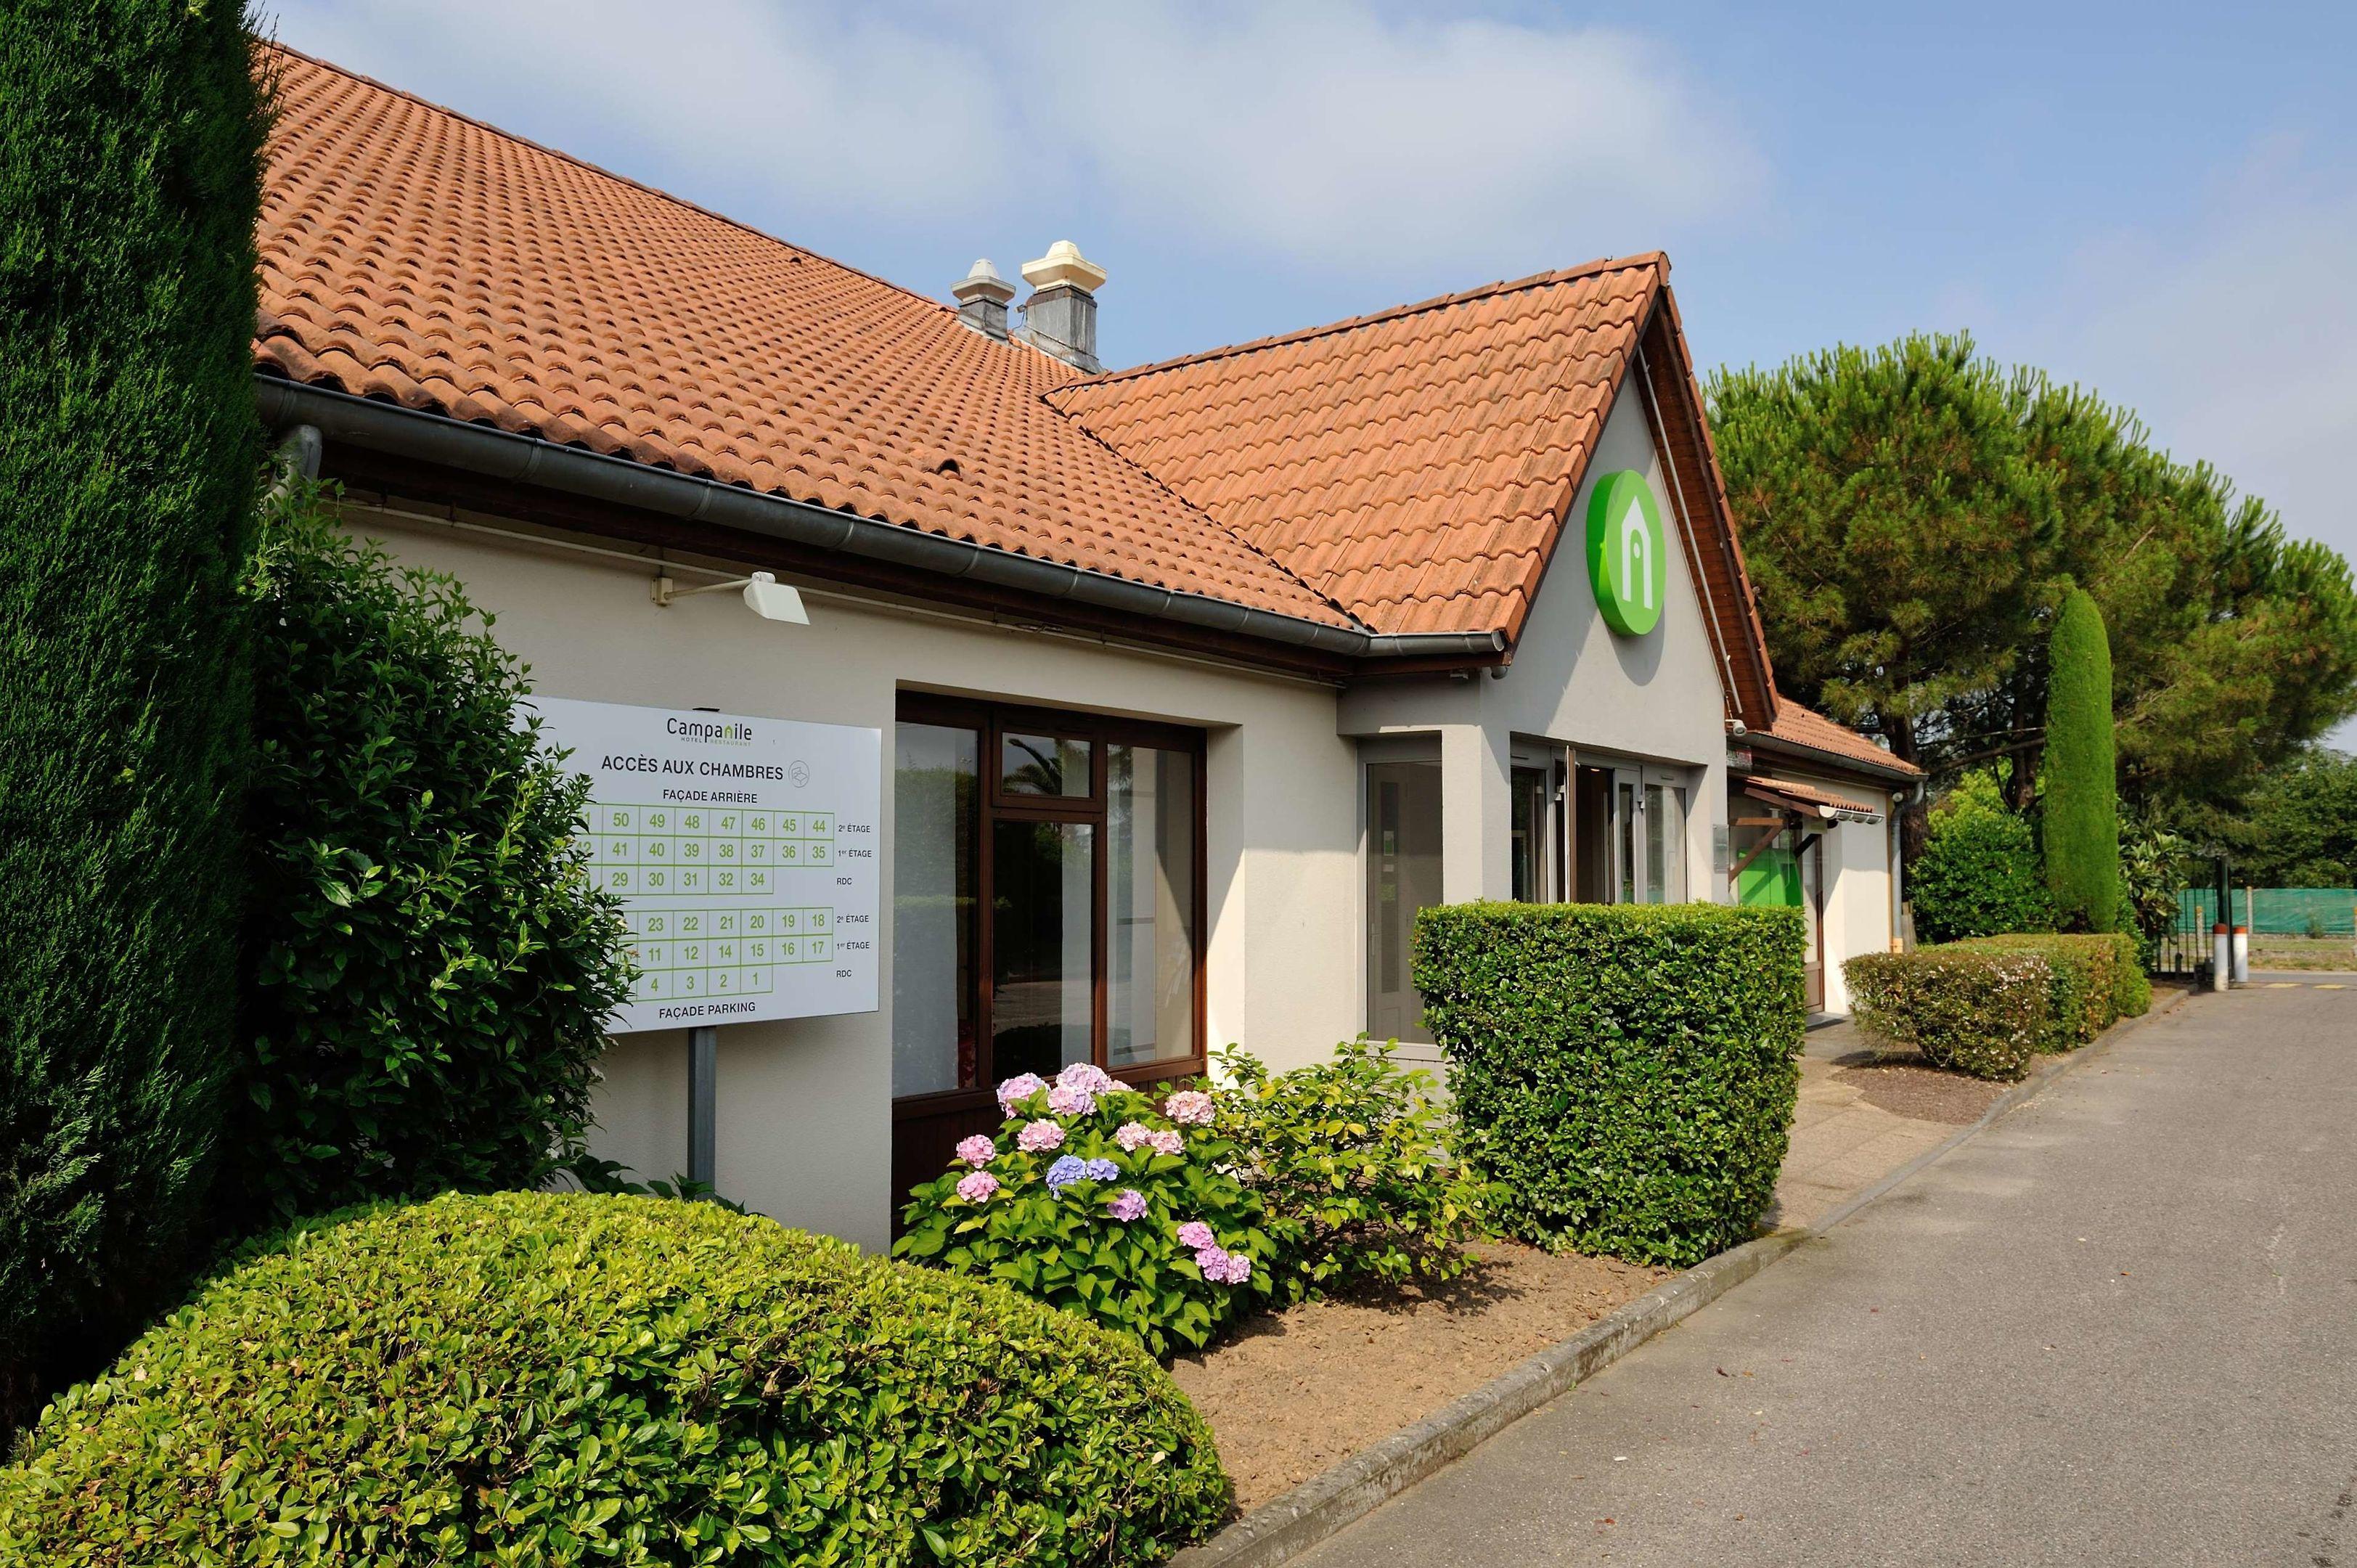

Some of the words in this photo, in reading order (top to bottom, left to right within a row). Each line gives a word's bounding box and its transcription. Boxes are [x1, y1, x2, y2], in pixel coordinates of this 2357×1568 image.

[667, 718, 752, 743] Campanile
[602, 754, 658, 772] ACCÈS
[662, 760, 694, 775] AUX
[700, 762, 783, 780] CHAMBRES
[663, 789, 708, 802] FAÇADE
[711, 791, 757, 803] ARRIÈRE
[613, 813, 629, 827] 50
[649, 814, 665, 828] 49
[685, 815, 700, 829] 48
[722, 817, 735, 830] 47
[751, 818, 765, 831] 46
[783, 820, 796, 832] 45
[812, 820, 826, 832] 44
[847, 822, 870, 833] ÉTAGE
[613, 842, 627, 856] 41
[649, 843, 664, 857] 40
[685, 844, 698, 857] 39
[719, 844, 733, 857] 38
[751, 845, 765, 857] 37
[783, 846, 796, 858] 36
[812, 846, 825, 858] 35
[849, 848, 872, 857] ÉTAGE
[612, 872, 628, 886] 29
[648, 873, 664, 886] 30
[684, 873, 698, 886] 31
[719, 873, 733, 886] 32
[751, 873, 765, 886] 34
[648, 918, 663, 931] 23
[683, 917, 698, 931] 22
[720, 915, 733, 929] 21
[750, 915, 764, 928] 20
[782, 915, 795, 928] 19
[812, 914, 825, 927] 18
[846, 914, 869, 923] ÉTAGE
[648, 948, 661, 962] 11
[684, 946, 698, 960] 12
[719, 945, 732, 958] 14
[751, 944, 764, 957] 15
[782, 942, 795, 955] 16
[812, 942, 825, 954] 17
[846, 940, 870, 950] ÉTAGE
[650, 978, 658, 992] 4
[687, 976, 695, 989] 3
[720, 974, 727, 987] 2
[753, 972, 758, 986] 1
[659, 1006, 704, 1020] FAÇADE
[708, 1002, 756, 1015] PARKING
